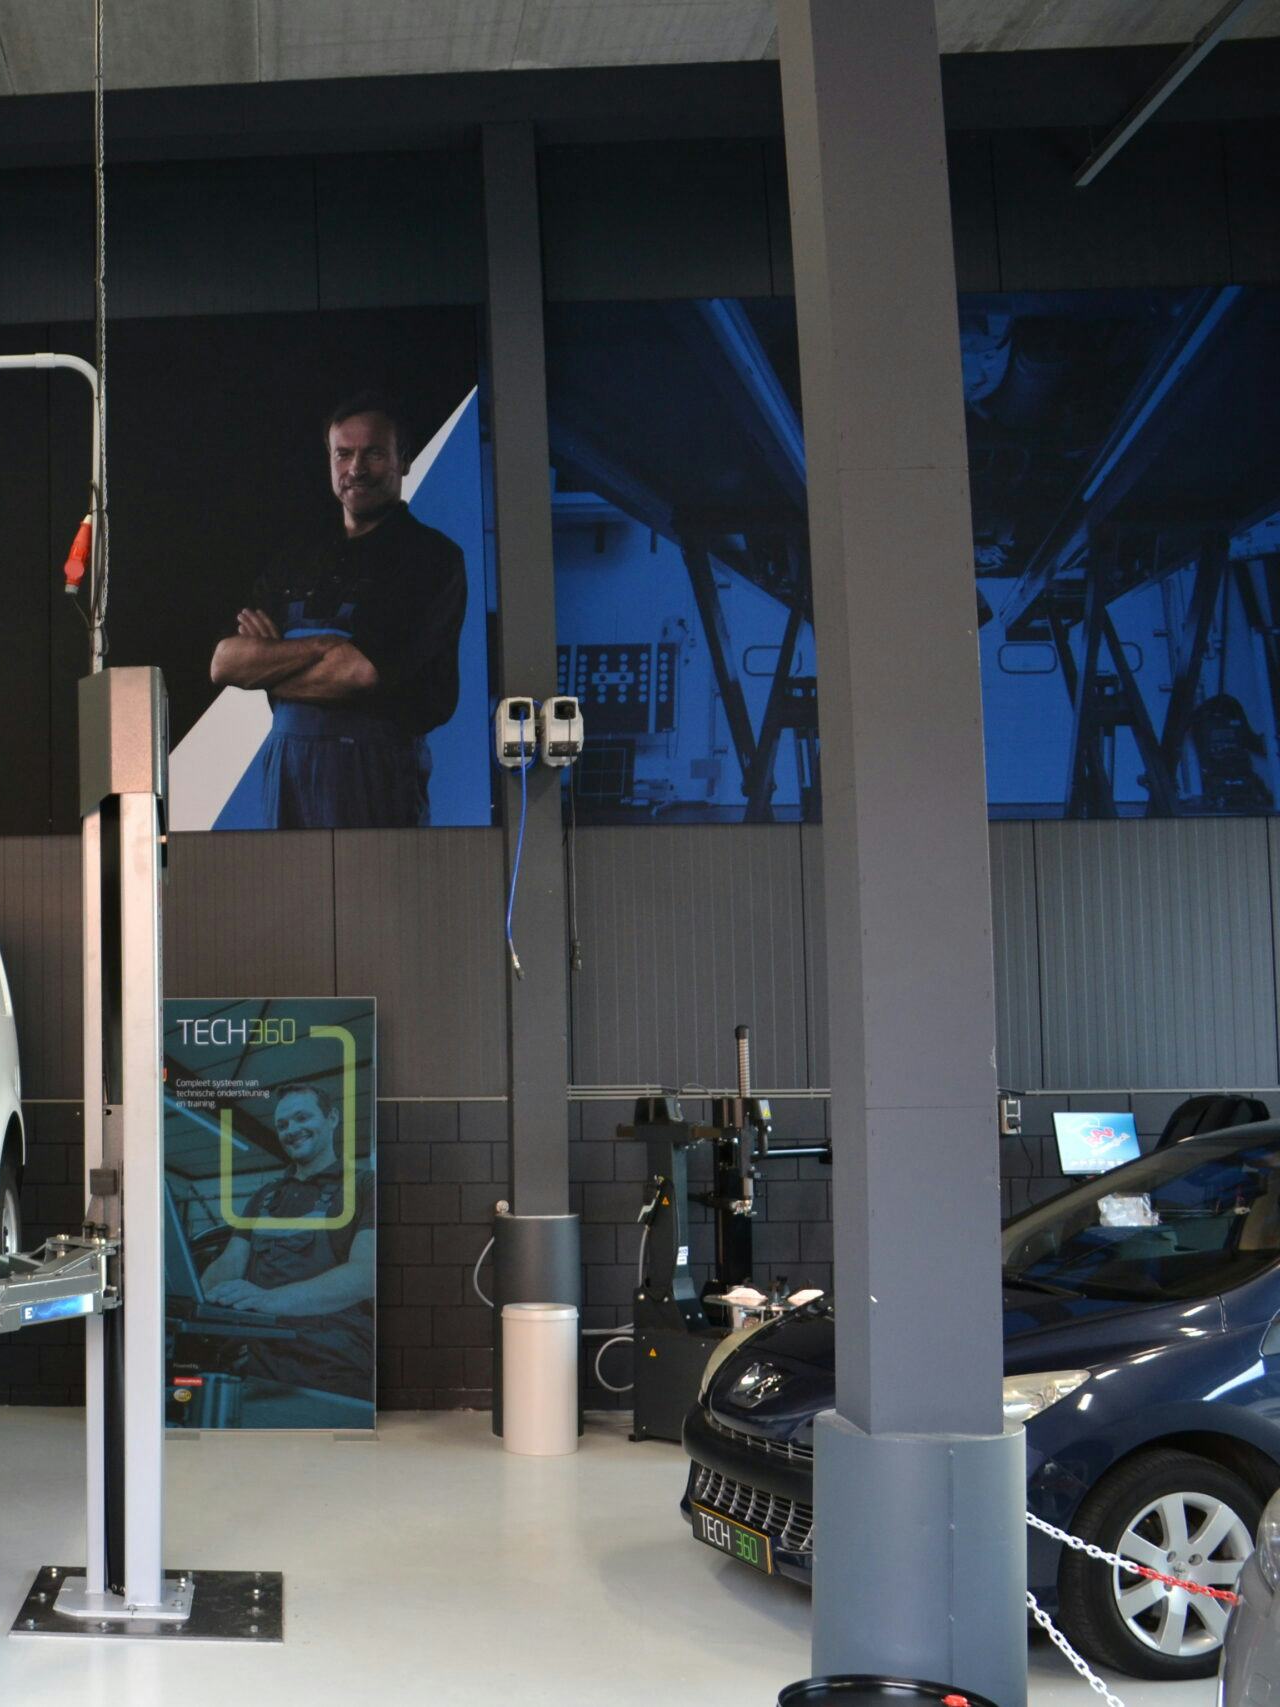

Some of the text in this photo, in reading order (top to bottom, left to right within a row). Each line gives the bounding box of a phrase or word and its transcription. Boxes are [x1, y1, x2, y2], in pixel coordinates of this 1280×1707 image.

[176, 1079, 211, 1088] Compleet
[212, 1080, 244, 1088] systeem
[217, 1090, 270, 1099] ondersteuning
[699, 1511, 759, 1564] TECH 360
